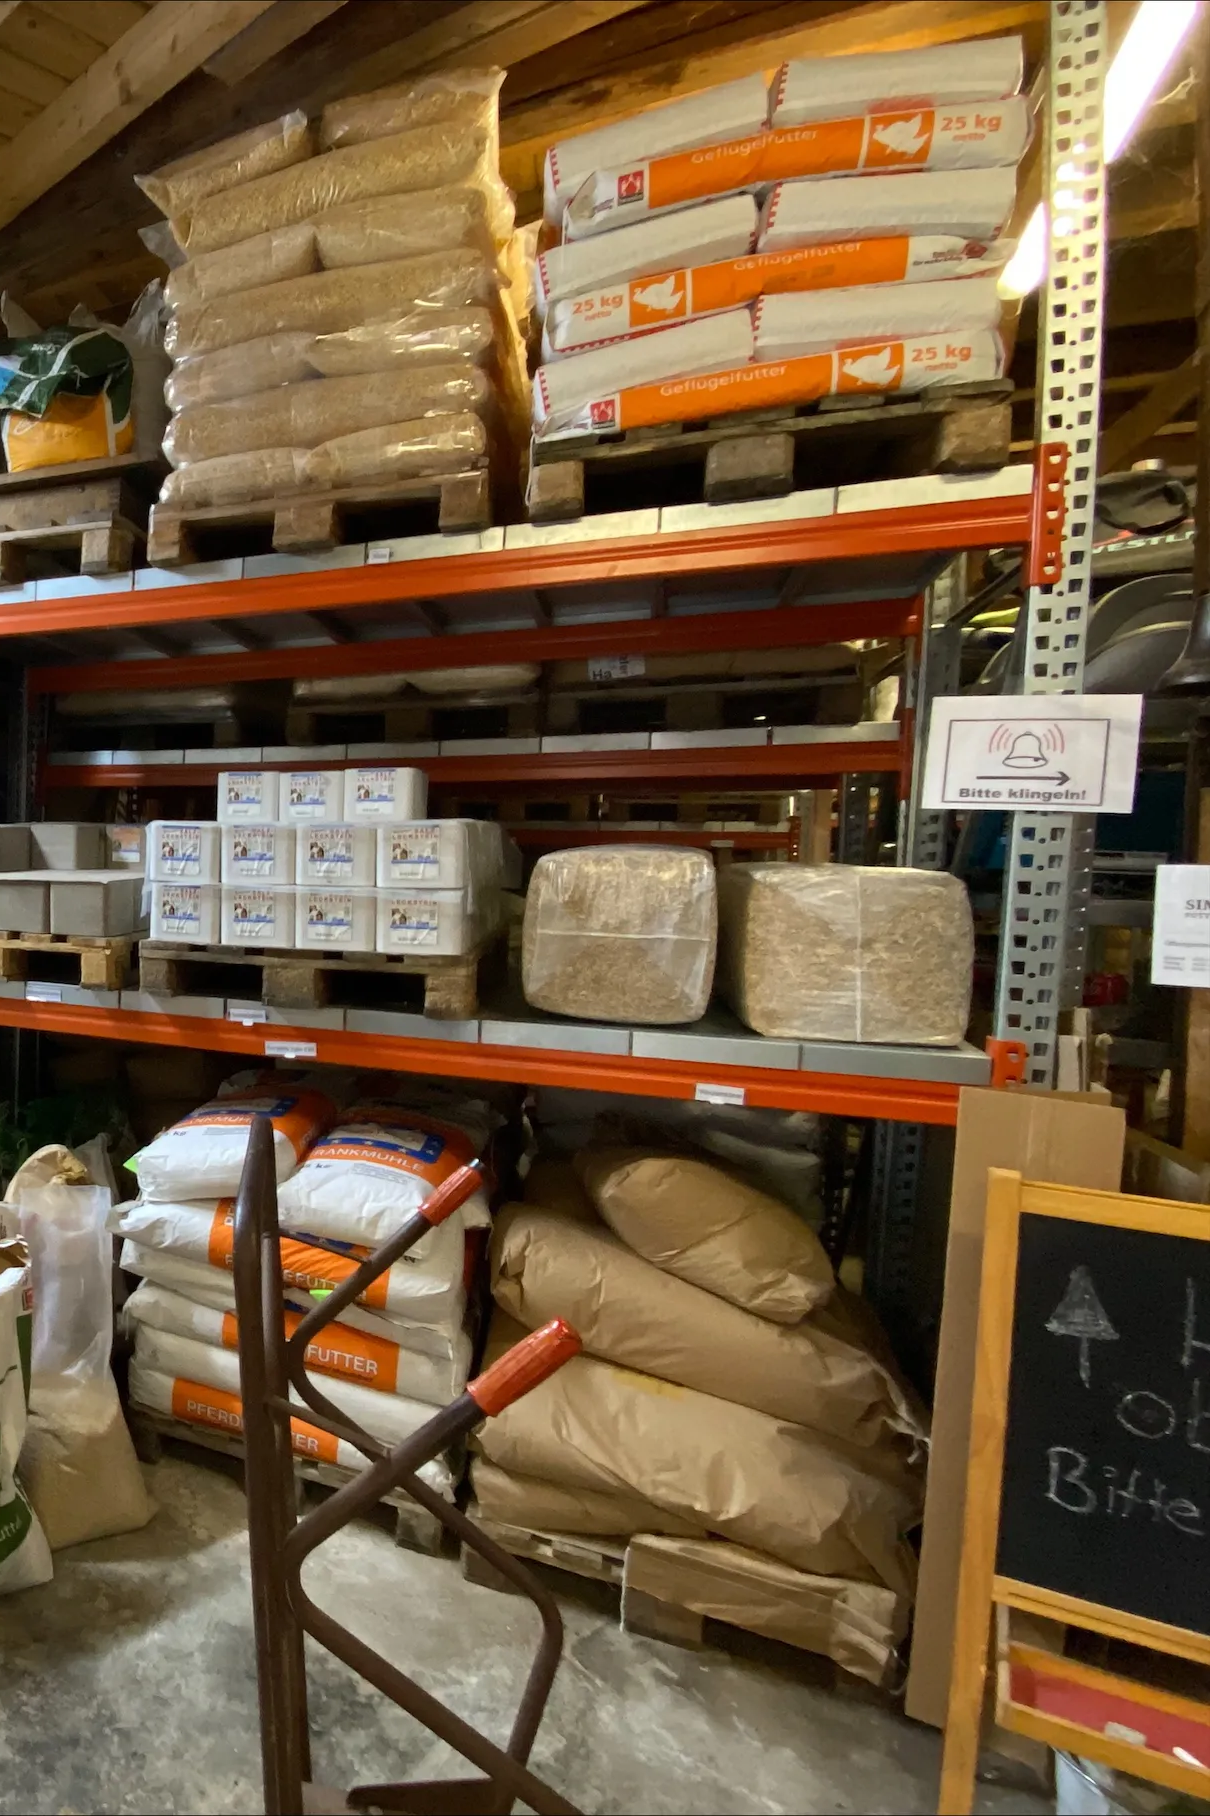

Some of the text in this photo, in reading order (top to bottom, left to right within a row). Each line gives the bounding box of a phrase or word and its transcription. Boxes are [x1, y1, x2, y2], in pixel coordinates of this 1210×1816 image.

[940, 113, 1002, 133] 25 kg
[572, 293, 624, 315] 25 kg
[910, 343, 972, 363] 25 kg
[659, 364, 788, 397] Geflügelfutter
[958, 787, 1087, 802] Bitte klingeln!
[1045, 1446, 1205, 1536] Bitte
